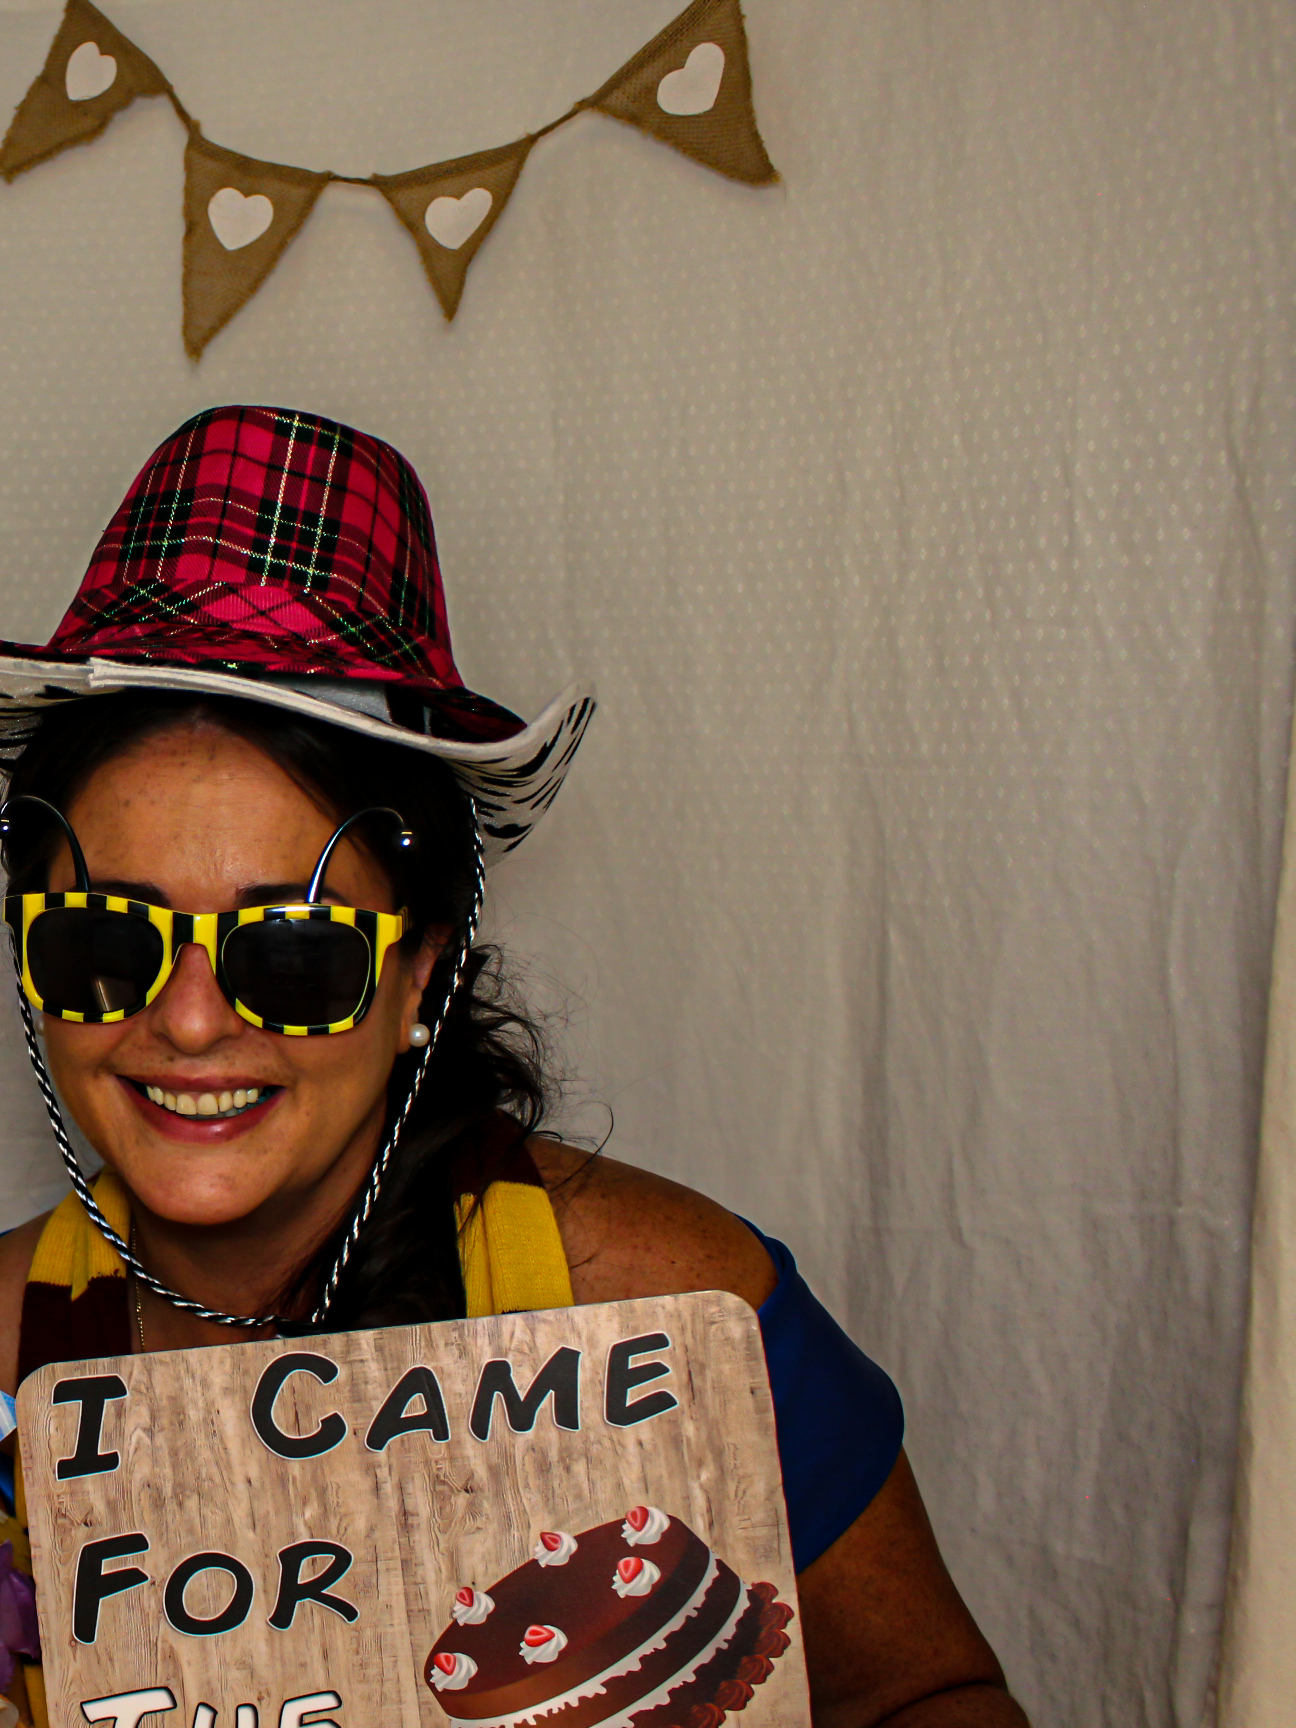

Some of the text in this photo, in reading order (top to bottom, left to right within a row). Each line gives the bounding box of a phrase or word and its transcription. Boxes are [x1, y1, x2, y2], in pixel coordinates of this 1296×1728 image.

[52, 1331, 679, 1481] I CAME
[71, 1531, 360, 1645] FOR
